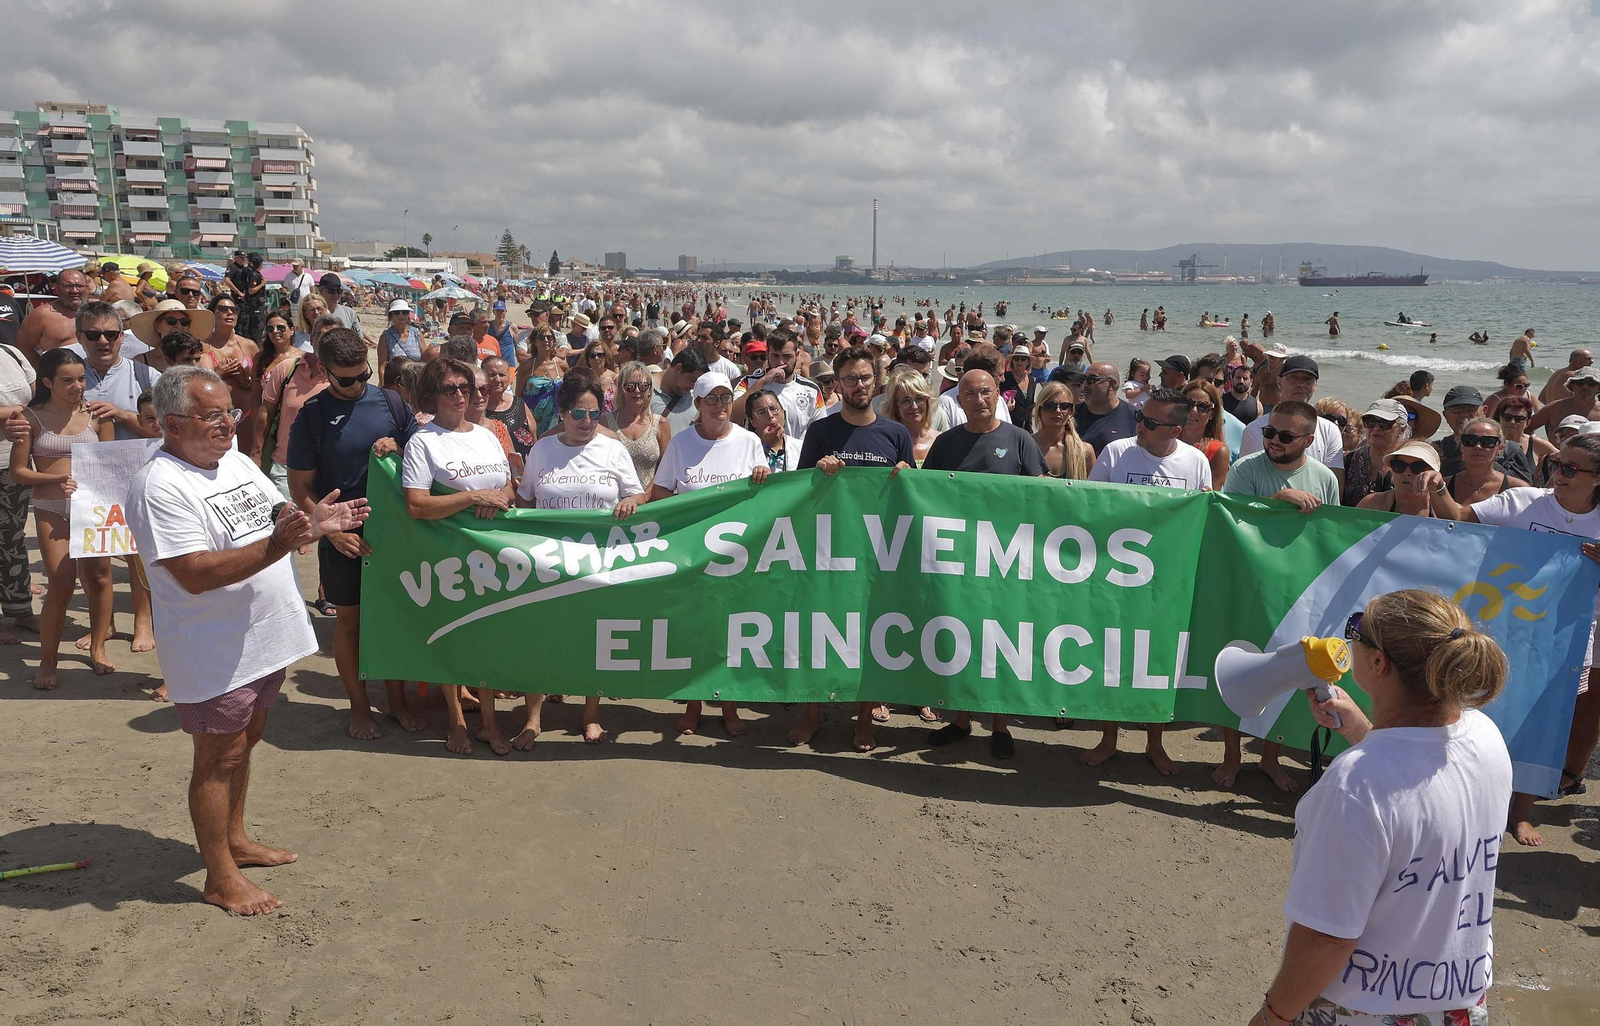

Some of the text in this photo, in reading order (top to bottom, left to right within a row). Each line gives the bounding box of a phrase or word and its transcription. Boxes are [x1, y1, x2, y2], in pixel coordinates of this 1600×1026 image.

[833, 451, 853, 460] Pedro
[854, 452, 864, 460] del
[1141, 476, 1171, 486] PLAYA
[400, 521, 669, 607] VERDEMAR
[703, 513, 1155, 587] SALVEMOS
[595, 611, 1264, 690] EL RINCONCILL
[1457, 892, 1492, 931] EL
